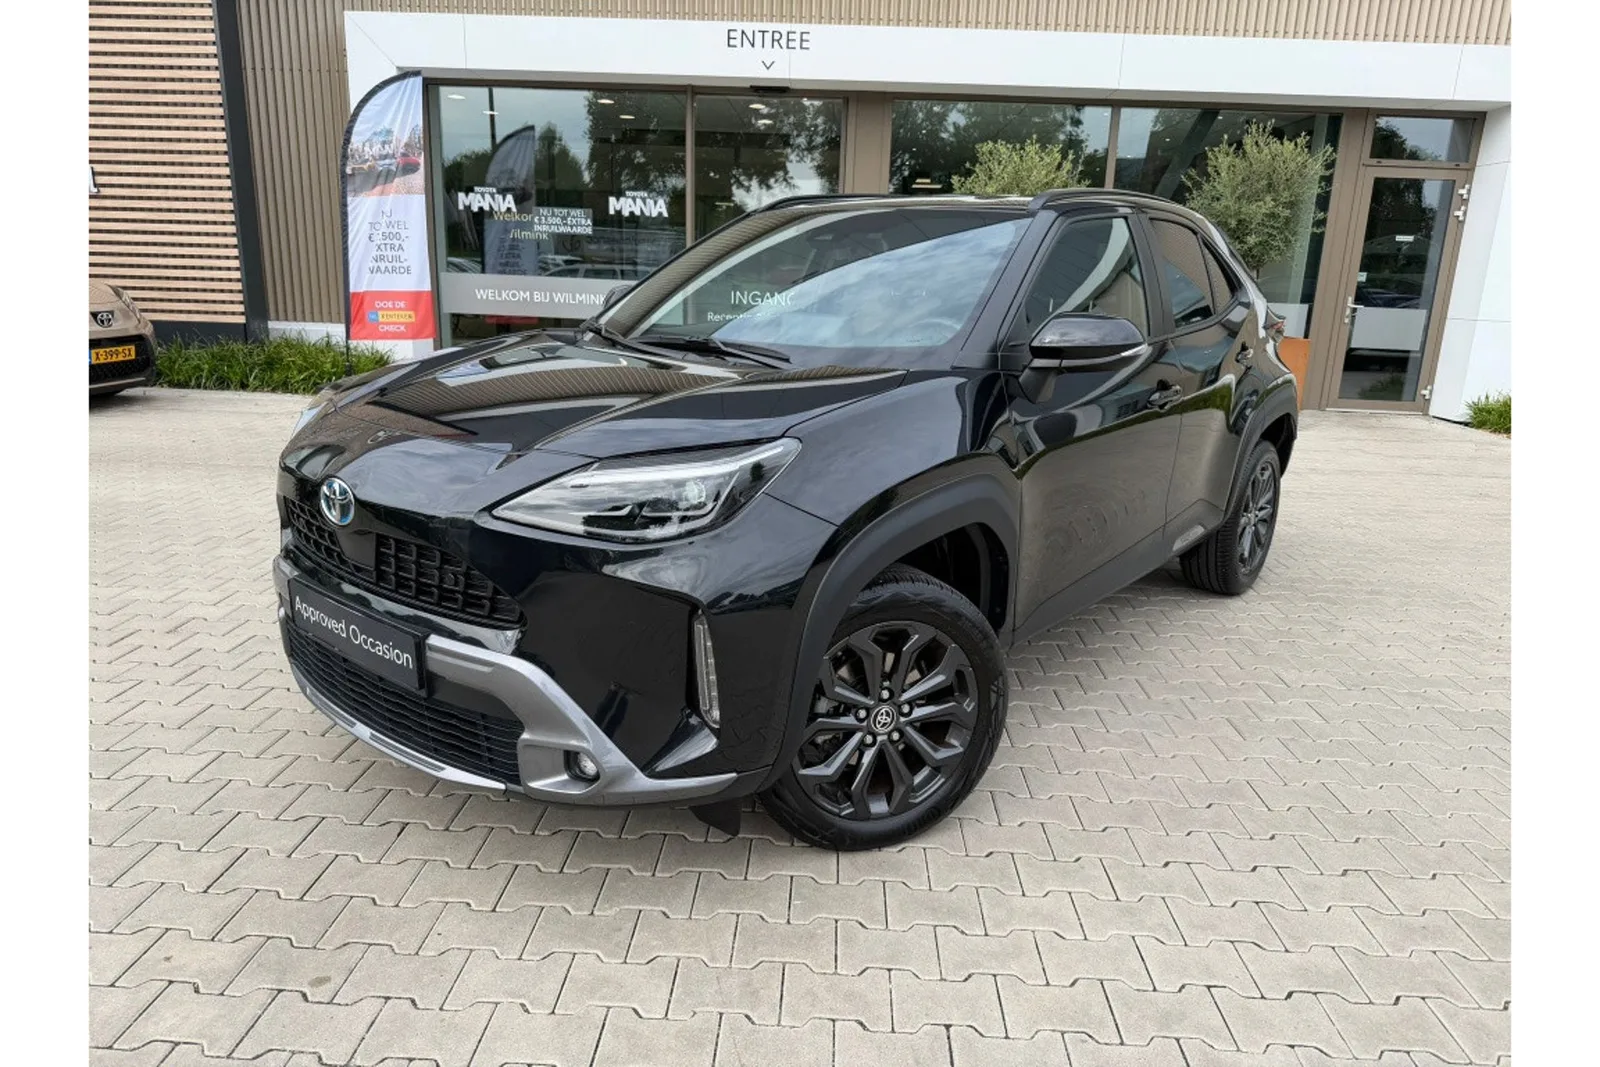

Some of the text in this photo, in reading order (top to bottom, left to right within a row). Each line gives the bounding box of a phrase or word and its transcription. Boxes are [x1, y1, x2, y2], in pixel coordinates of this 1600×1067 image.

[727, 29, 811, 50] ENTREE
[457, 191, 517, 213] MANIA
[608, 196, 669, 218] MANIA
[475, 288, 530, 301] WELKOM
[534, 292, 549, 302] BIJ
[94, 348, 133, 362] X-399-SX
[295, 595, 413, 669] Approved Occasion
